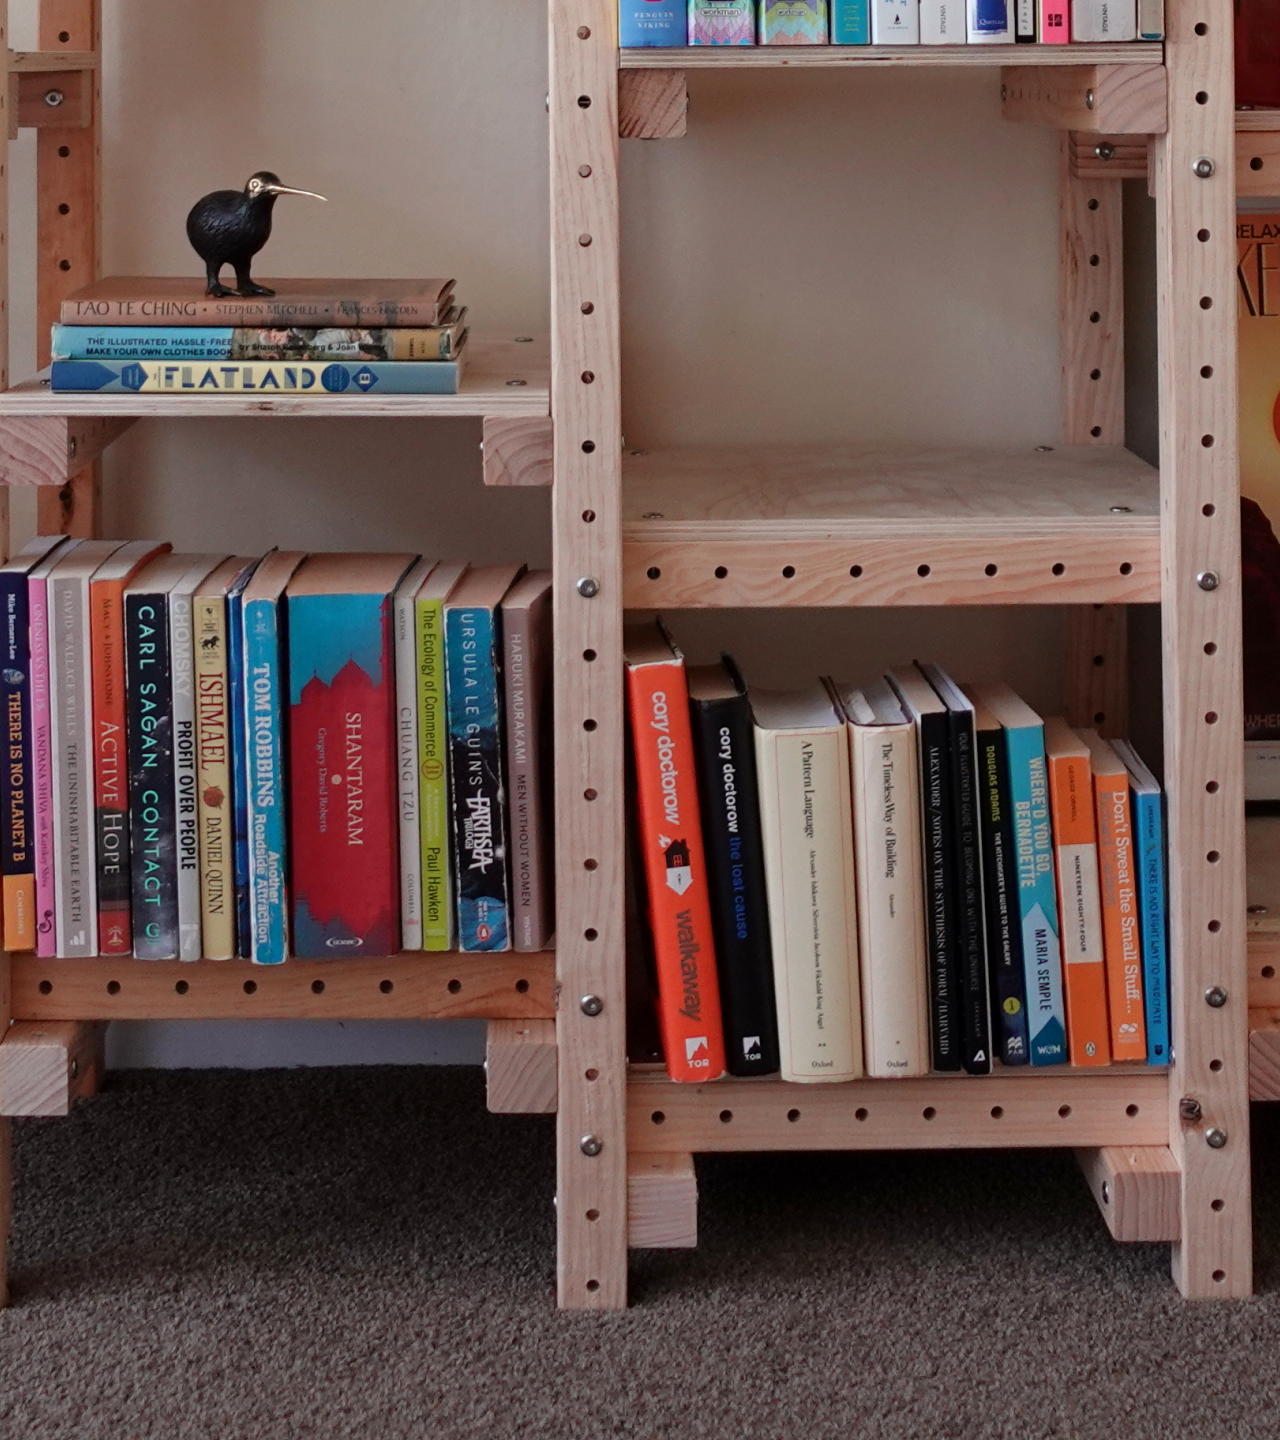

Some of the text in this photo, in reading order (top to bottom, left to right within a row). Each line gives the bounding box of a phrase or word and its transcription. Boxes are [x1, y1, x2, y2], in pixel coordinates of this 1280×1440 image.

[76, 301, 197, 316] TAO TE CHING
[164, 348, 205, 356] CLOTHES
[165, 367, 316, 389] FLATLAND
[199, 672, 224, 771] ISHMAEL
[252, 663, 274, 807] TOM ROBBINS
[421, 633, 438, 757] Ecology Commerce
[462, 614, 483, 785] URSULA LE GUIN'S
[510, 634, 526, 763] HARUKI MURAKAMI
[8, 692, 24, 847] THERE NO PLANET
[138, 606, 161, 907] CARL SAGAN CONTACT
[177, 721, 196, 870] PROFIT OVER PEOPLE
[344, 713, 363, 845] SHANTARAM
[401, 707, 414, 822] CHUANG TZU
[651, 691, 680, 824] cory doctorow
[801, 752, 816, 838] Pattern Language
[987, 746, 1000, 821] DOUGLAS ADAMS
[1030, 757, 1048, 849] WHERE'D YOU
[67, 744, 82, 922] THE UNINHABITABLE EARTH
[206, 818, 223, 914] DANIEL QUINN
[427, 847, 440, 872] Paul
[517, 775, 531, 907] MEN WITHOUT WOMEN
[883, 762, 897, 878] Timeless Way Building
[1015, 802, 1036, 887] BERNADETTE
[428, 876, 441, 921] Hawken
[1112, 791, 1139, 1013] Don't Sweat the Small Stuff...
[675, 910, 703, 1020] walkaway
[1035, 929, 1052, 1010] MARIA SEMPLE
